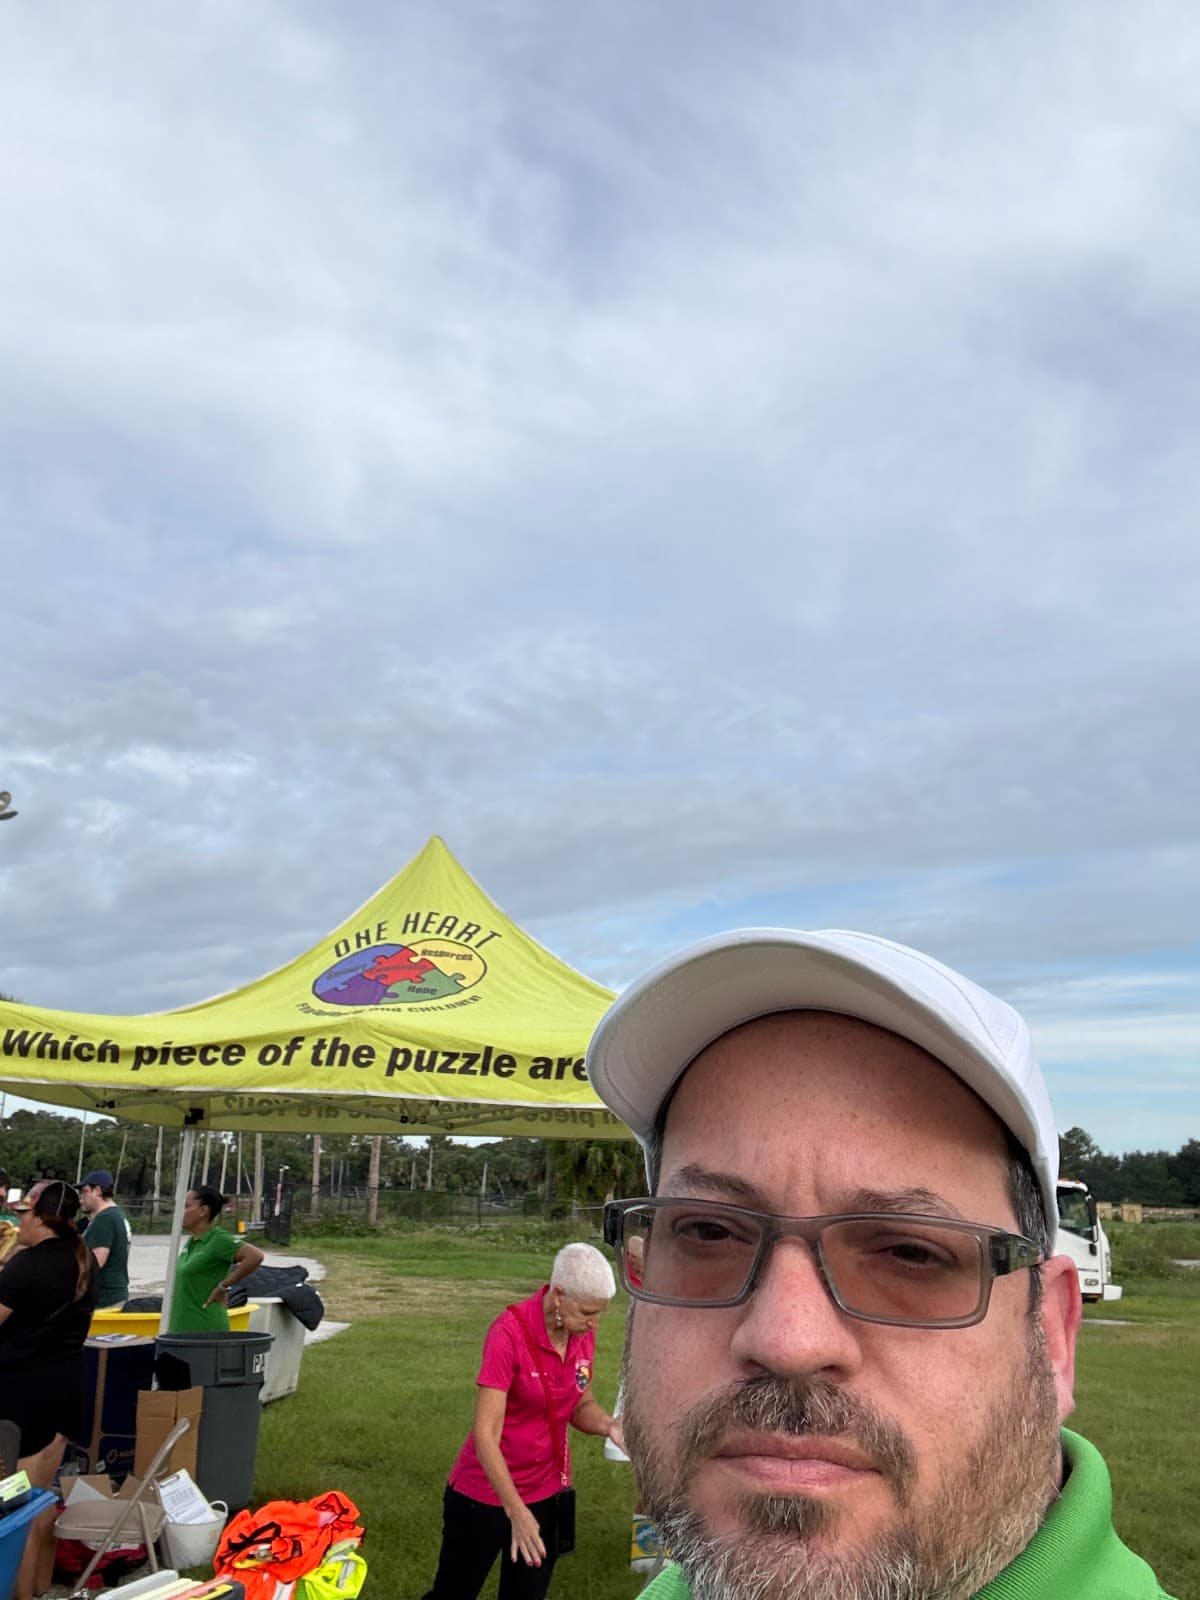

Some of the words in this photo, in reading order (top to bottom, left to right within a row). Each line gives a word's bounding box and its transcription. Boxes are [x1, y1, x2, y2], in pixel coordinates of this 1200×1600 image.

[334, 920, 388, 957] ONE
[402, 911, 502, 949] HEART
[2, 1029, 120, 1063] Which
[131, 1041, 246, 1071] piece
[258, 1036, 305, 1066] of
[310, 1036, 376, 1068] the
[385, 1046, 518, 1078] puzzle
[528, 1055, 589, 1081] are
